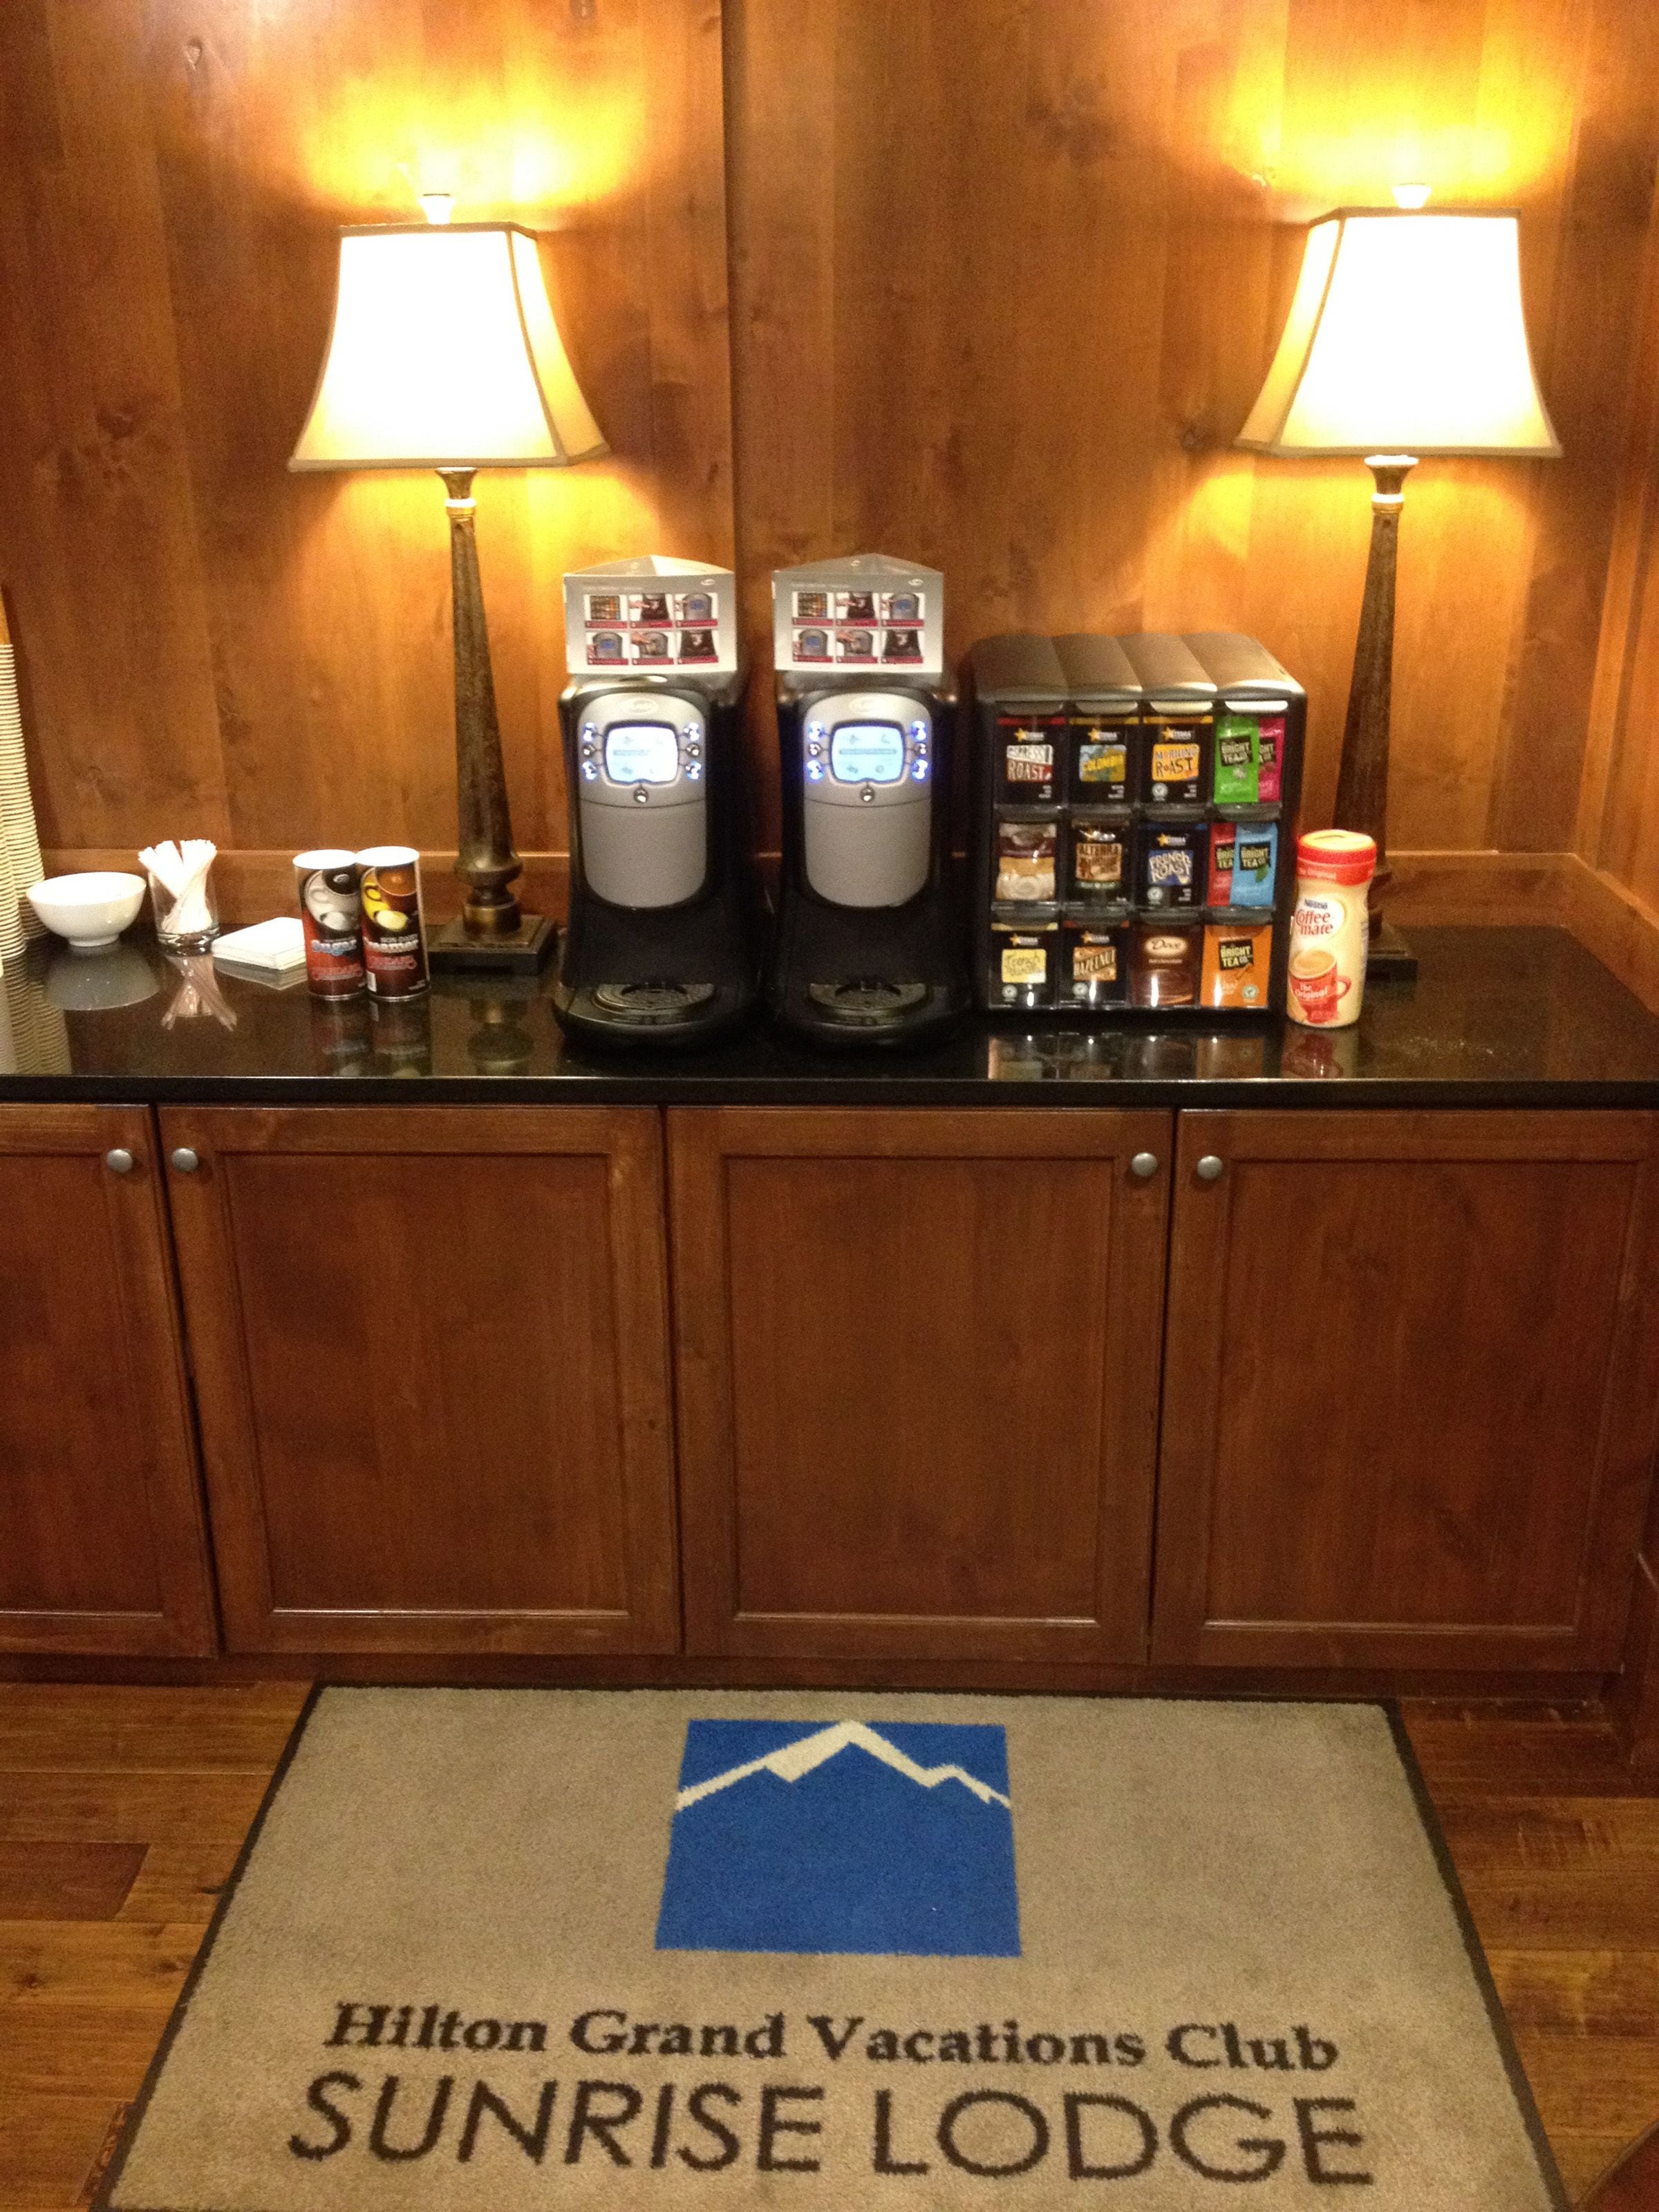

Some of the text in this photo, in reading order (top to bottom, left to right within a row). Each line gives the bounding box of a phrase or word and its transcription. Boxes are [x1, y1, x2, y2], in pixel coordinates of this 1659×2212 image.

[1007, 761, 1045, 782] ROAST
[1156, 757, 1193, 778] ROAST
[1151, 863, 1190, 882] ROAST
[1221, 946, 1251, 958] BRIGHT
[1222, 956, 1239, 967] TEA
[323, 2001, 1338, 2071] Hilton Grand Vacations Club
[285, 2069, 1374, 2188] SUNRISE LODGE
